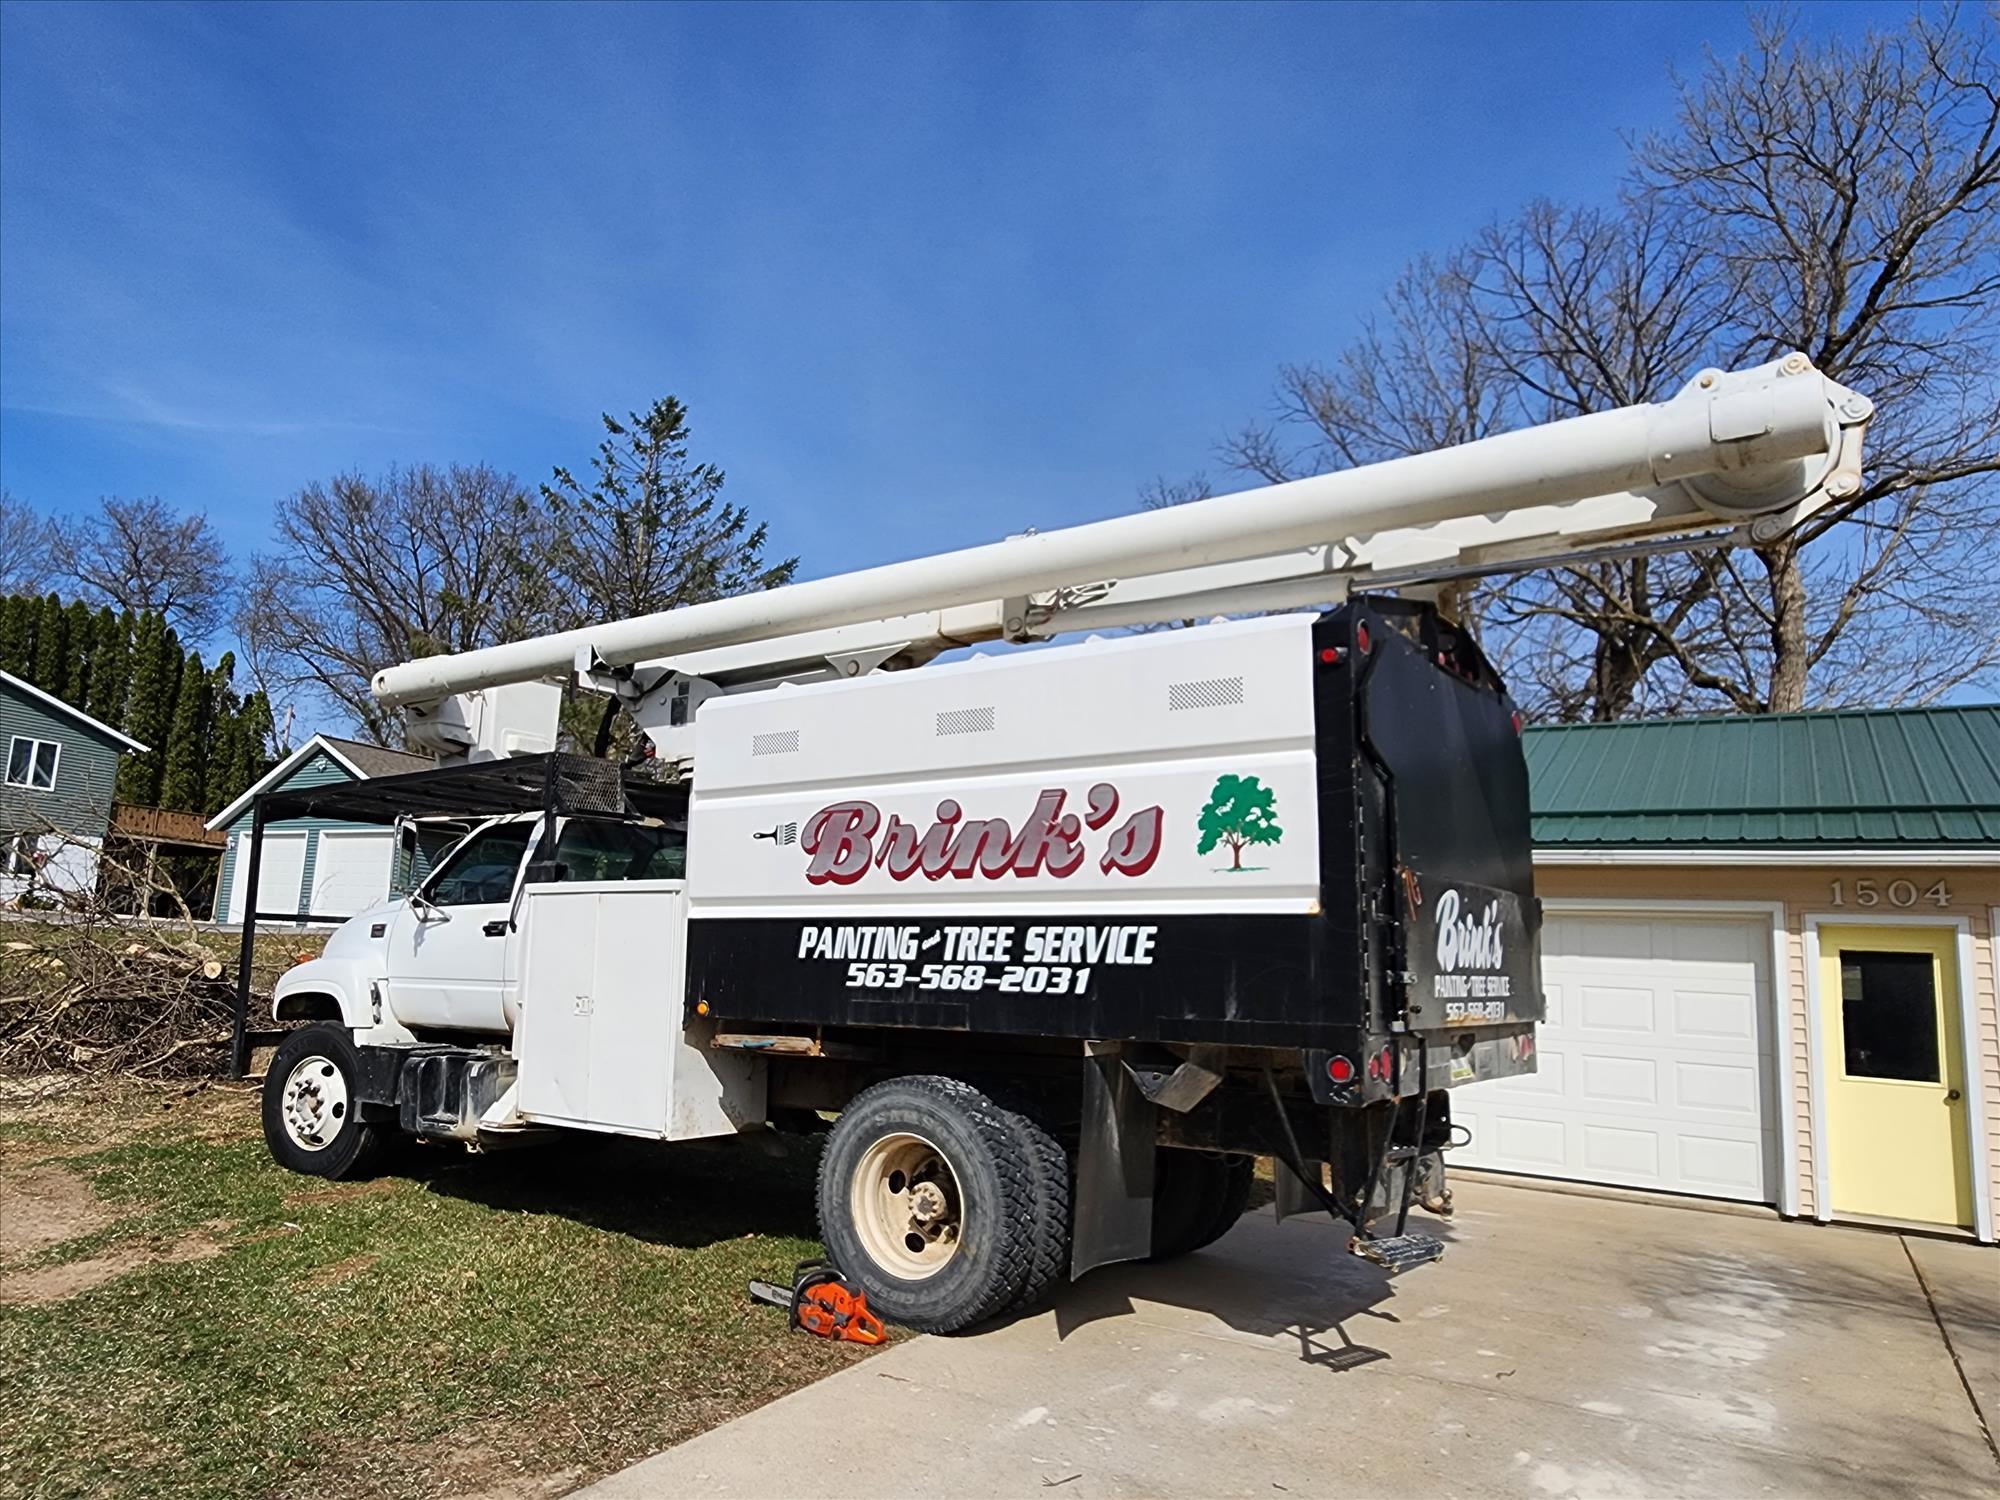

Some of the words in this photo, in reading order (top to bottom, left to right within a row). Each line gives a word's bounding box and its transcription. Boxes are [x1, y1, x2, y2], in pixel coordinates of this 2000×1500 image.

[801, 782, 1164, 885] Brink's
[1830, 880, 1952, 907] 1504
[798, 926, 920, 960] PAINTING
[943, 926, 1015, 962] TREE
[1023, 926, 1158, 964] SERVICE
[1436, 889, 1503, 972] Brink's
[845, 963, 1091, 994] 563-568-2031
